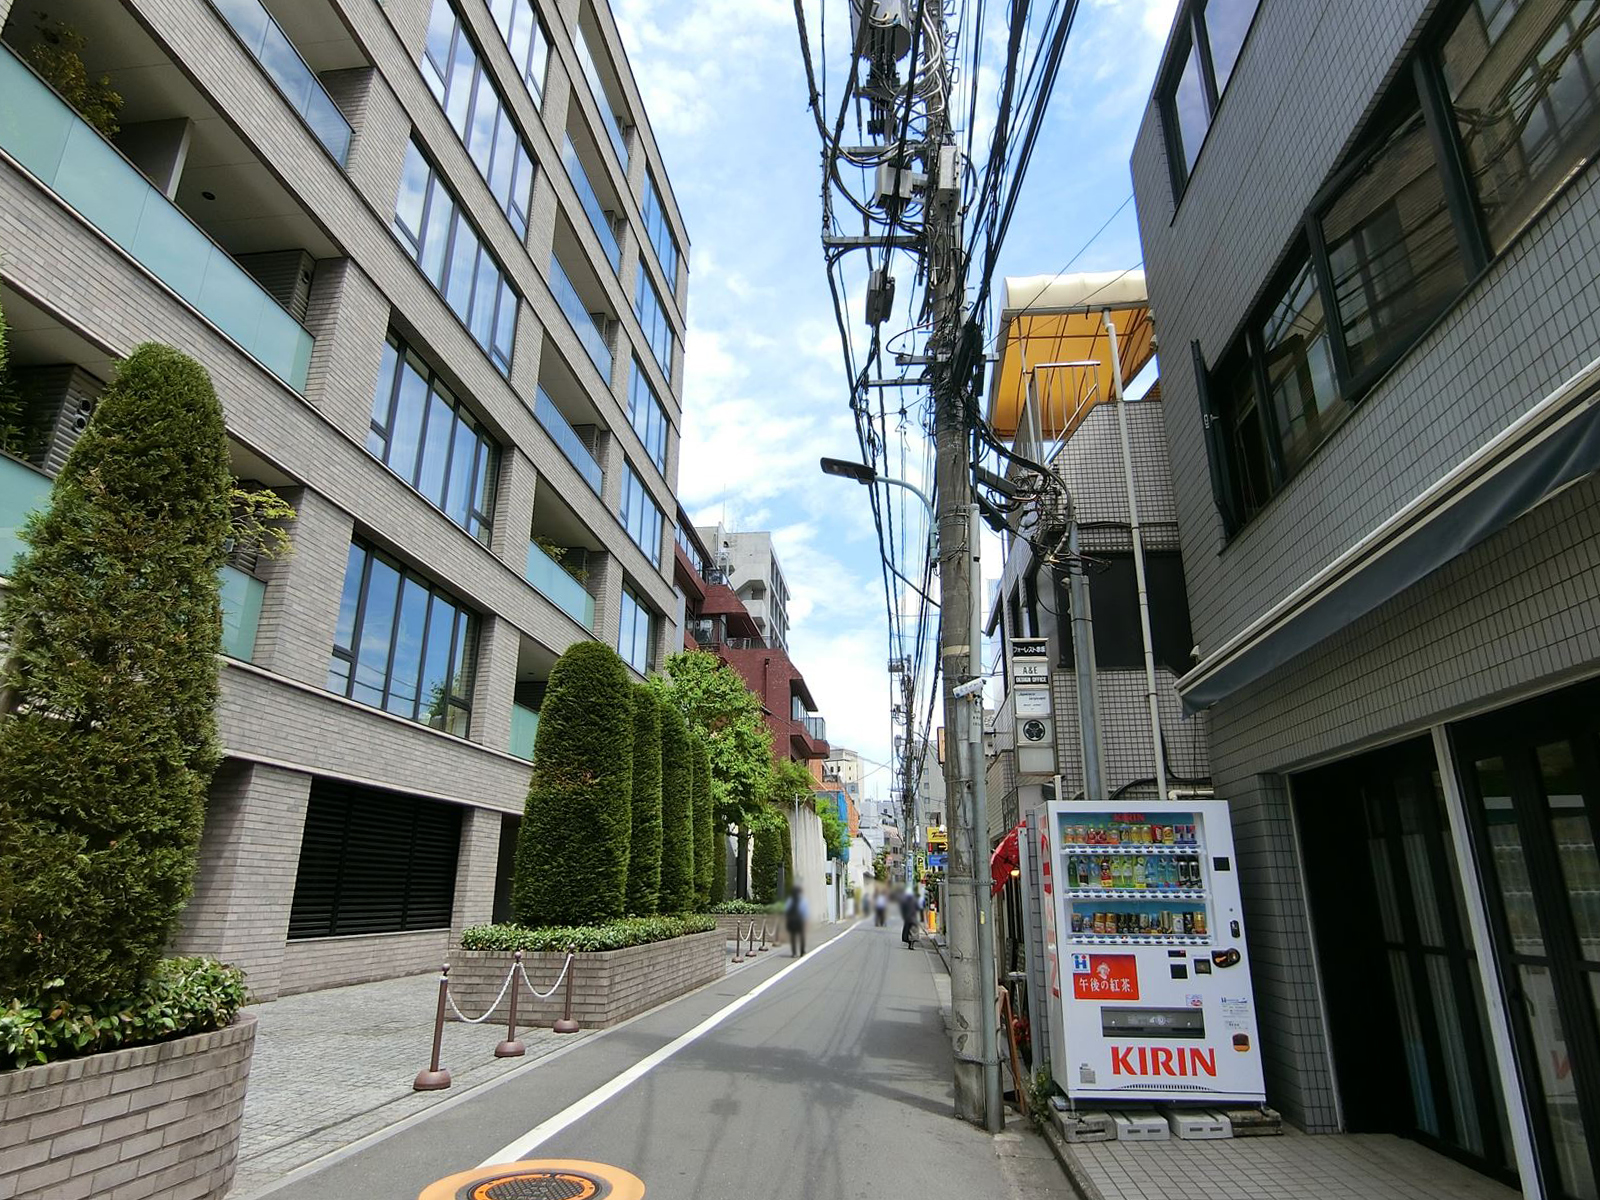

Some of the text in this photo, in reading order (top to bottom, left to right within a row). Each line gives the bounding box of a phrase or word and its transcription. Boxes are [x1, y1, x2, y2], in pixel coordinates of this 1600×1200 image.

[1112, 812, 1145, 822] KIRIN
[1079, 977, 1131, 992] 午後の紅茶
[1111, 1046, 1217, 1077] KIRIN
